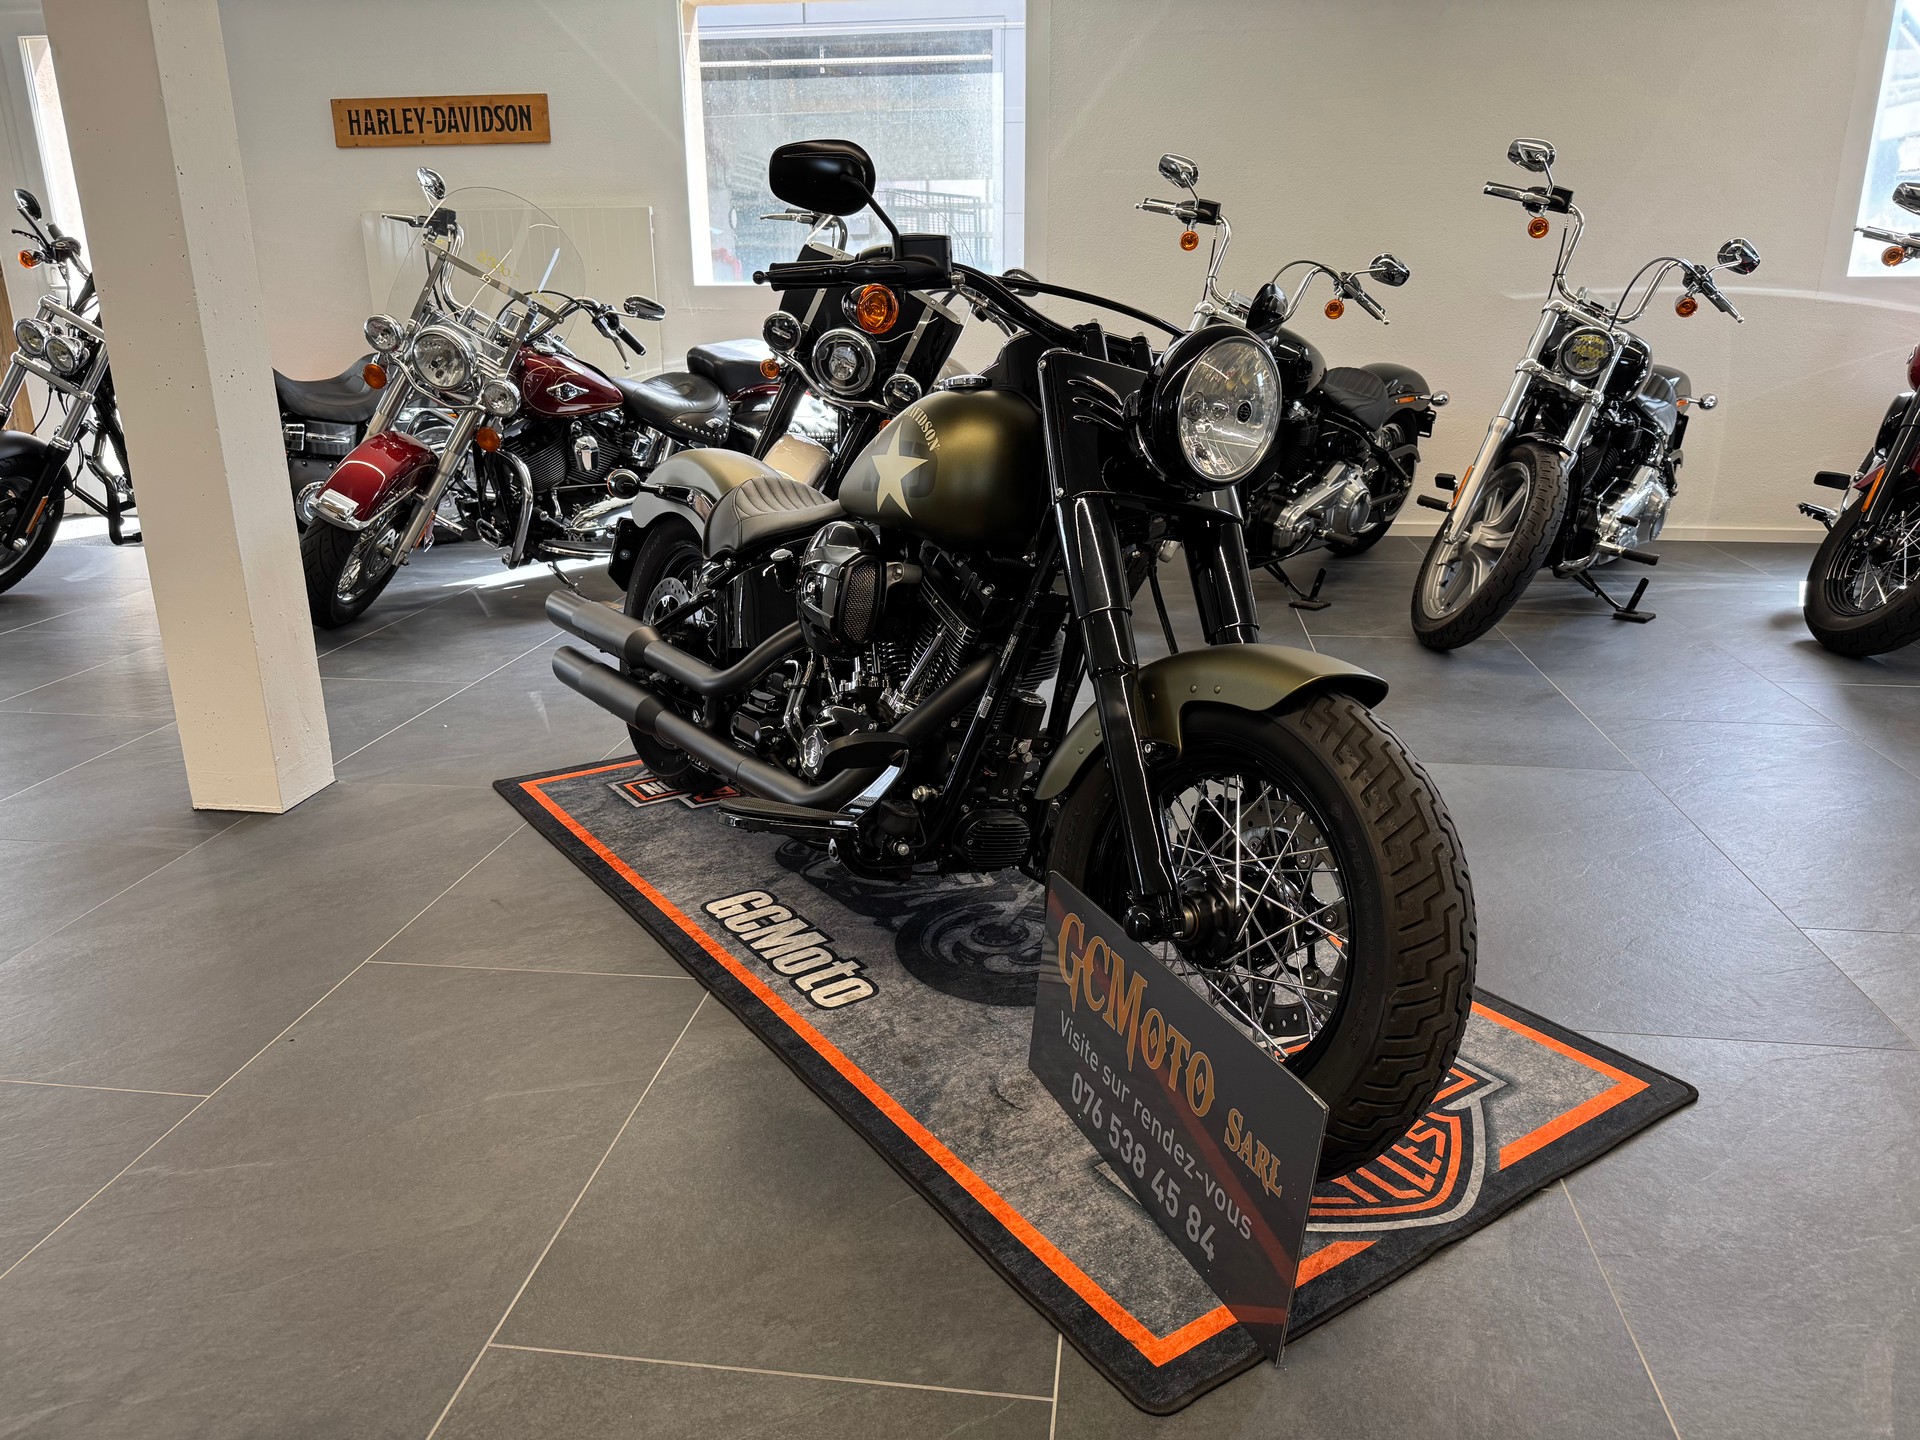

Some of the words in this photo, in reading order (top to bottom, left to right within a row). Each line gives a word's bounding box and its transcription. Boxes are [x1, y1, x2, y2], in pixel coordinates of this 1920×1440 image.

[347, 104, 532, 136] HARLEY-DAVIDSON
[704, 889, 876, 1009] GCMoto
[1059, 1009, 1100, 1073] Visite
[1102, 1063, 1131, 1099] sur
[1133, 1098, 1254, 1241] rendez-vous
[1071, 1071, 1104, 1130] 076
[1108, 1116, 1148, 1180] 538
[1151, 1167, 1180, 1219] 45
[1185, 1208, 1216, 1263] 84
[1224, 1107, 1284, 1198] SARL
